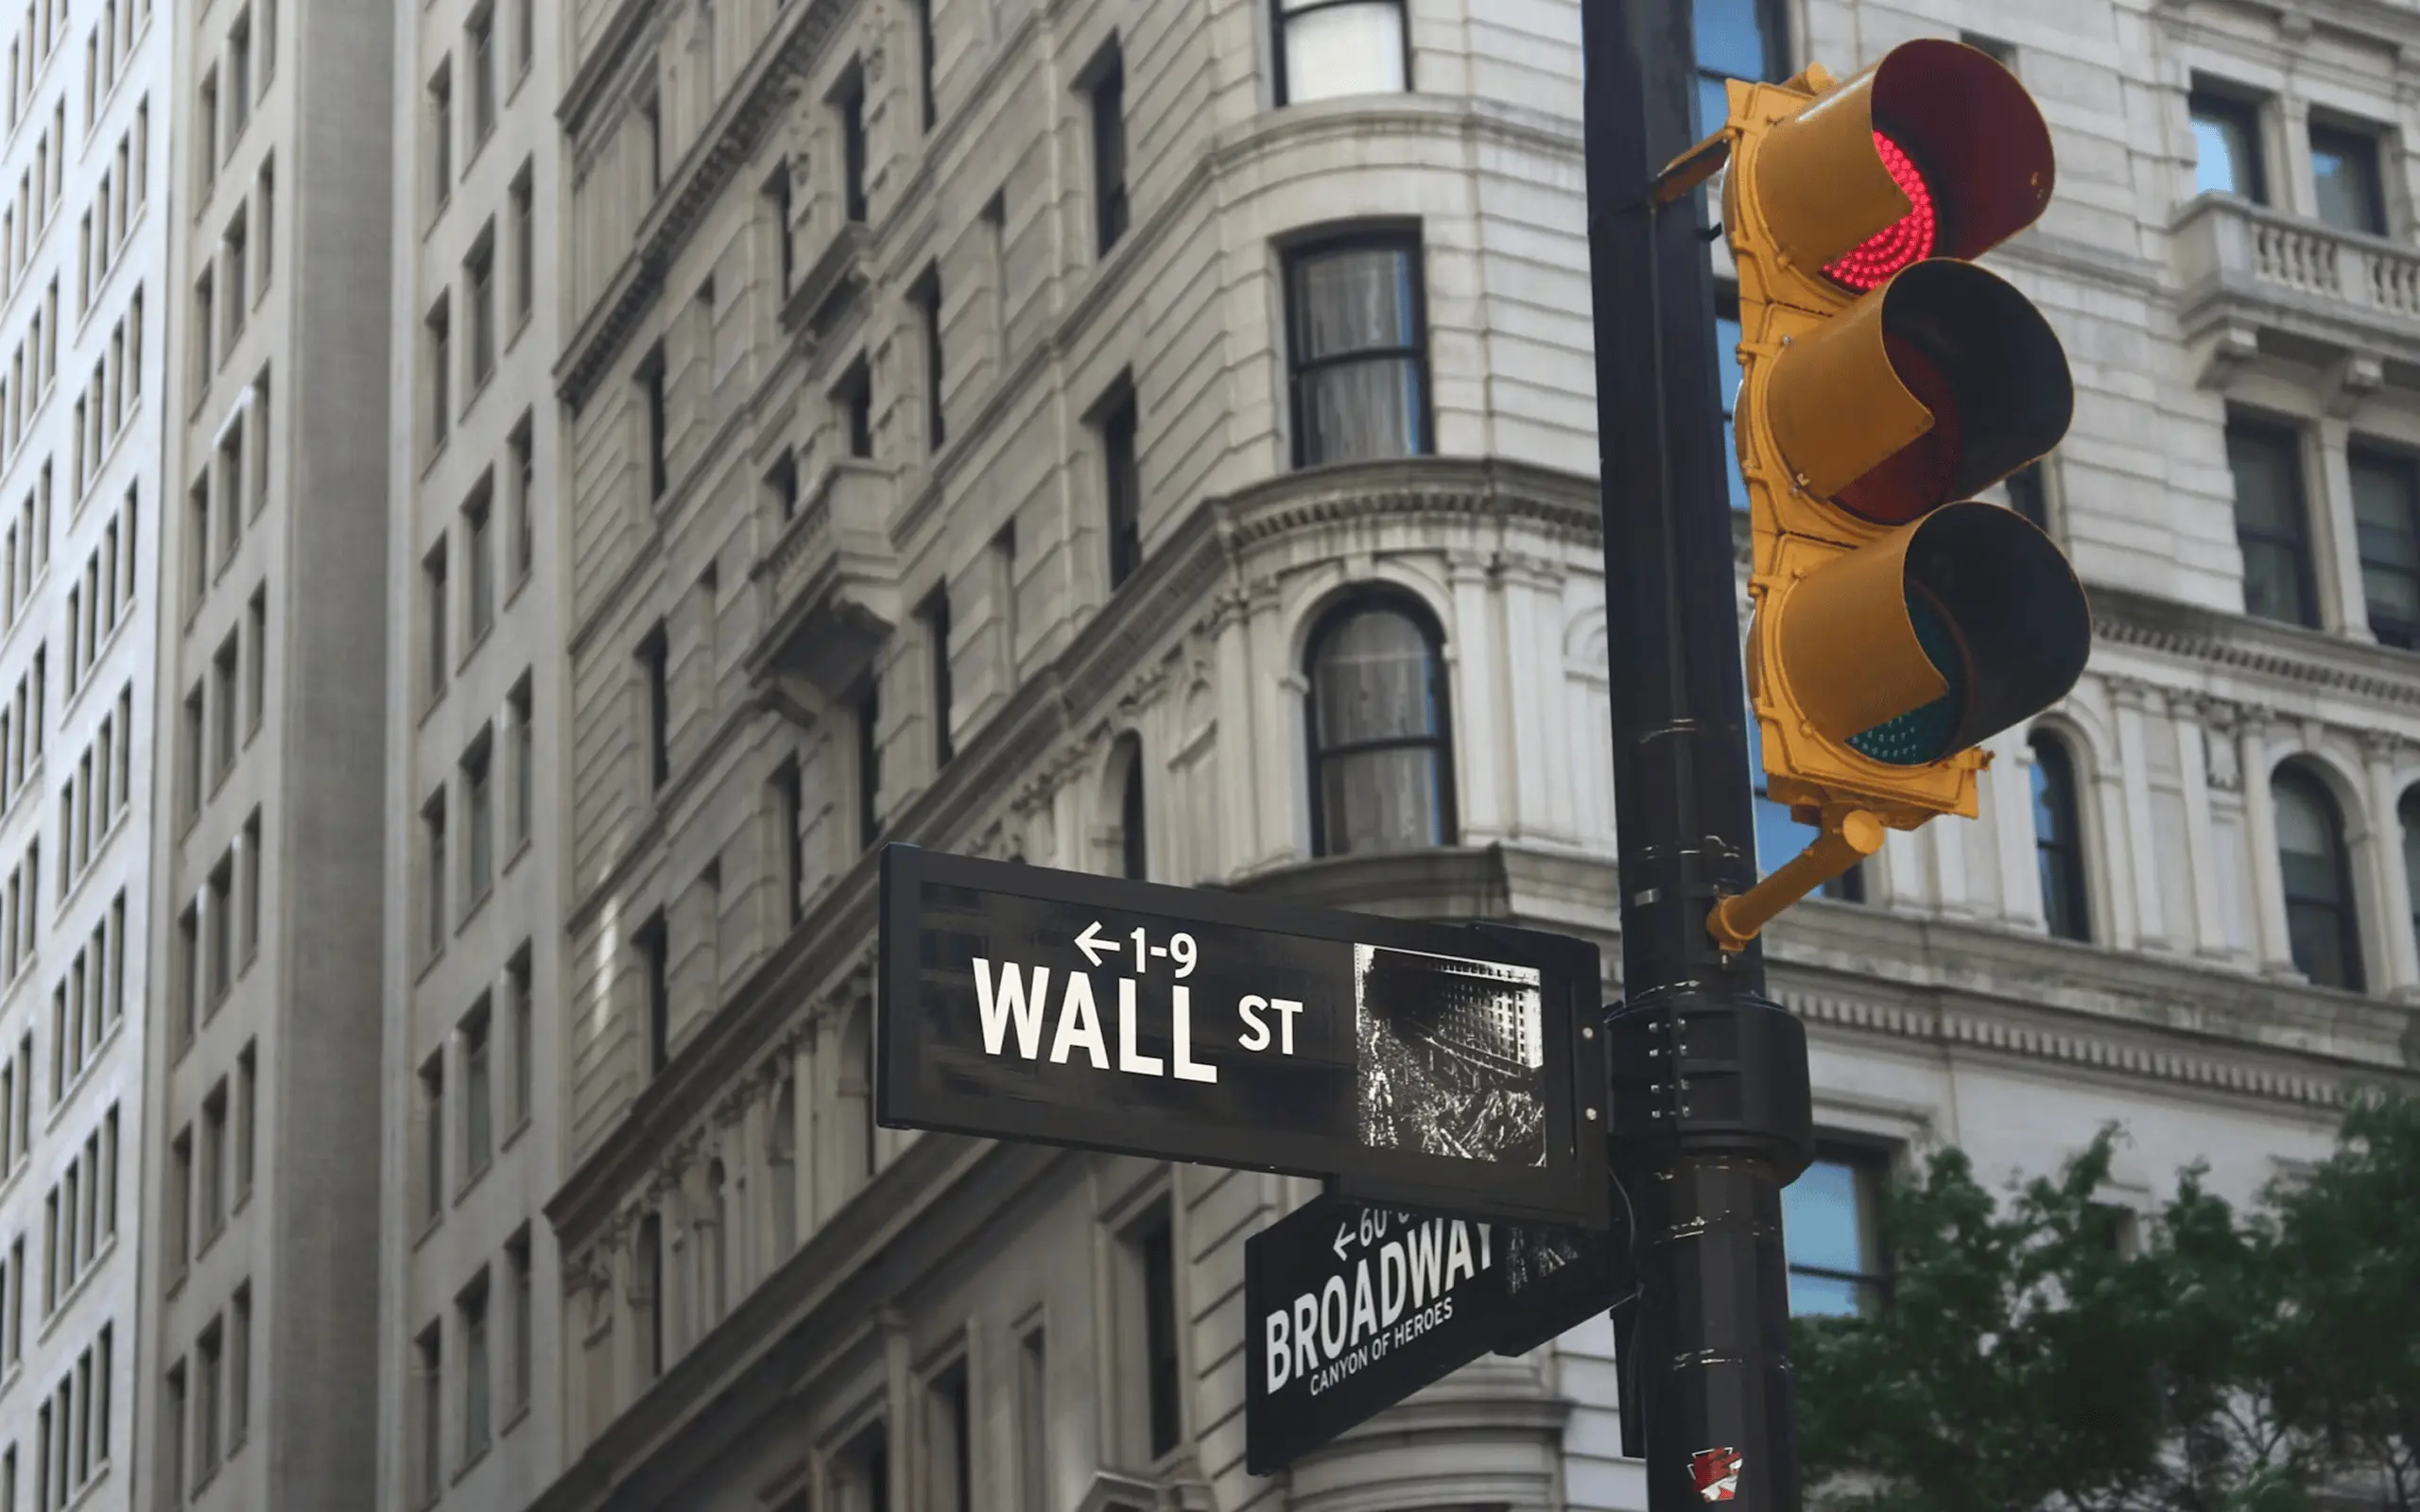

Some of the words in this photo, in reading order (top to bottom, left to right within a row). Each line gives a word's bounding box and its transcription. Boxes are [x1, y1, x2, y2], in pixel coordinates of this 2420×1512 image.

[1130, 926, 1198, 979] 1-9
[972, 956, 1218, 1084] WALL
[1237, 994, 1304, 1056] ST
[1266, 1217, 1492, 1395] BROADWAY
[1310, 1345, 1368, 1396] CANYON
[1372, 1332, 1391, 1361] OF
[1394, 1297, 1453, 1349] HEROES
